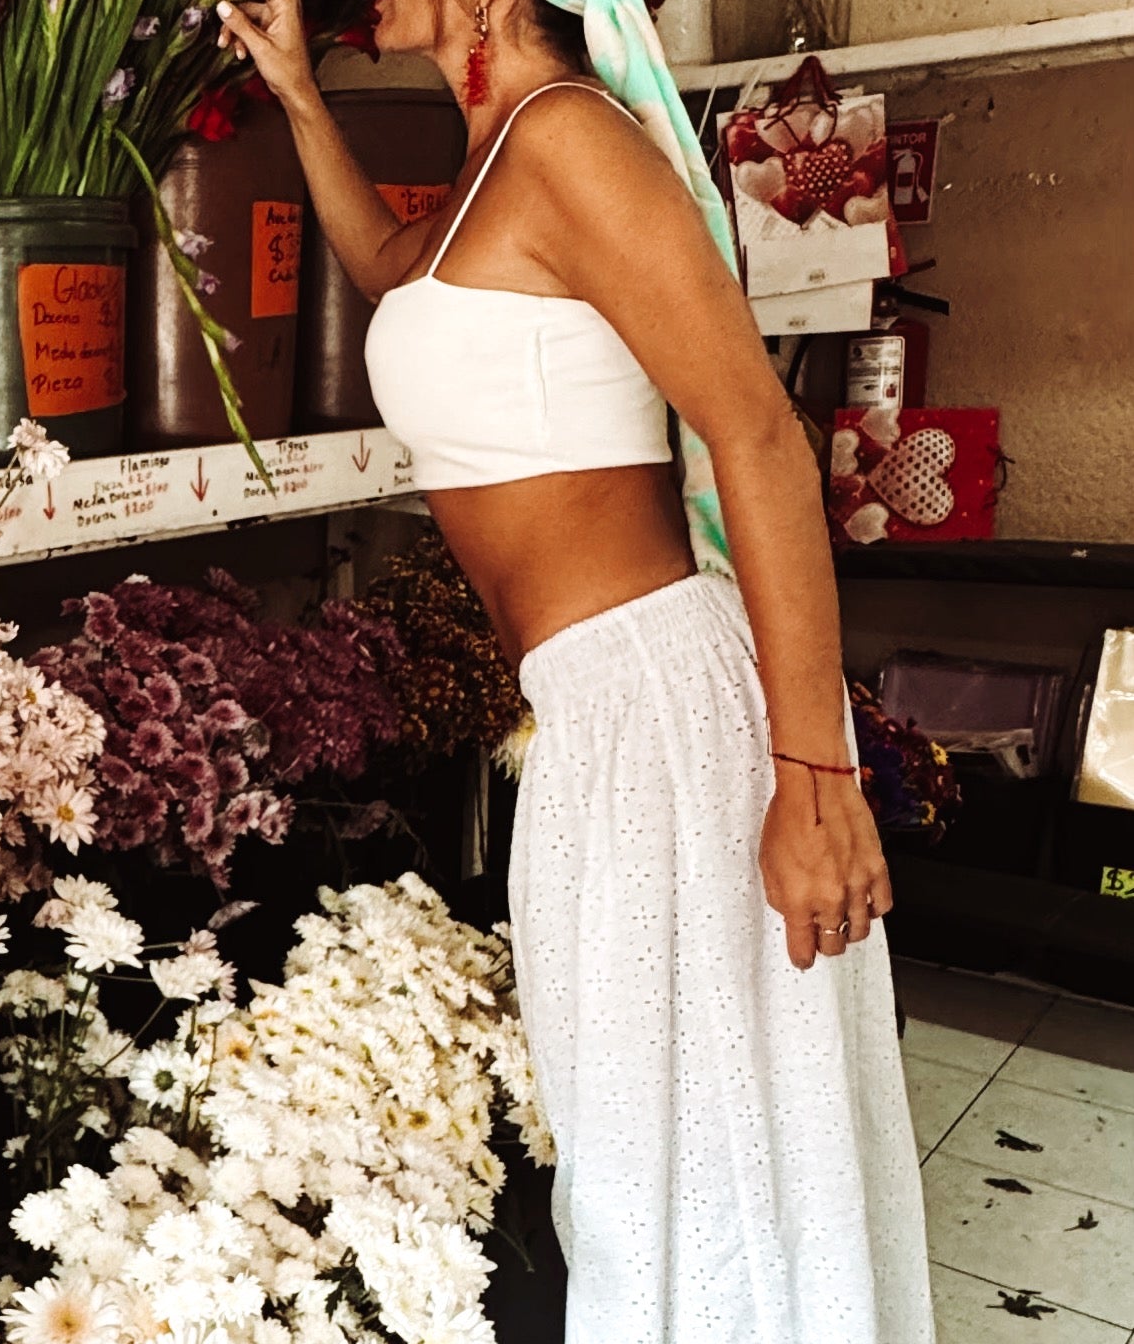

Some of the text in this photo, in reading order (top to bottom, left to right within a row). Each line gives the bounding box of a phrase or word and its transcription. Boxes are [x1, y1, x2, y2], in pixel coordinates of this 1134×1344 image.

[31, 373, 84, 395] Pieza
[120, 457, 170, 474] Flamingo
[125, 500, 154, 517] $200
